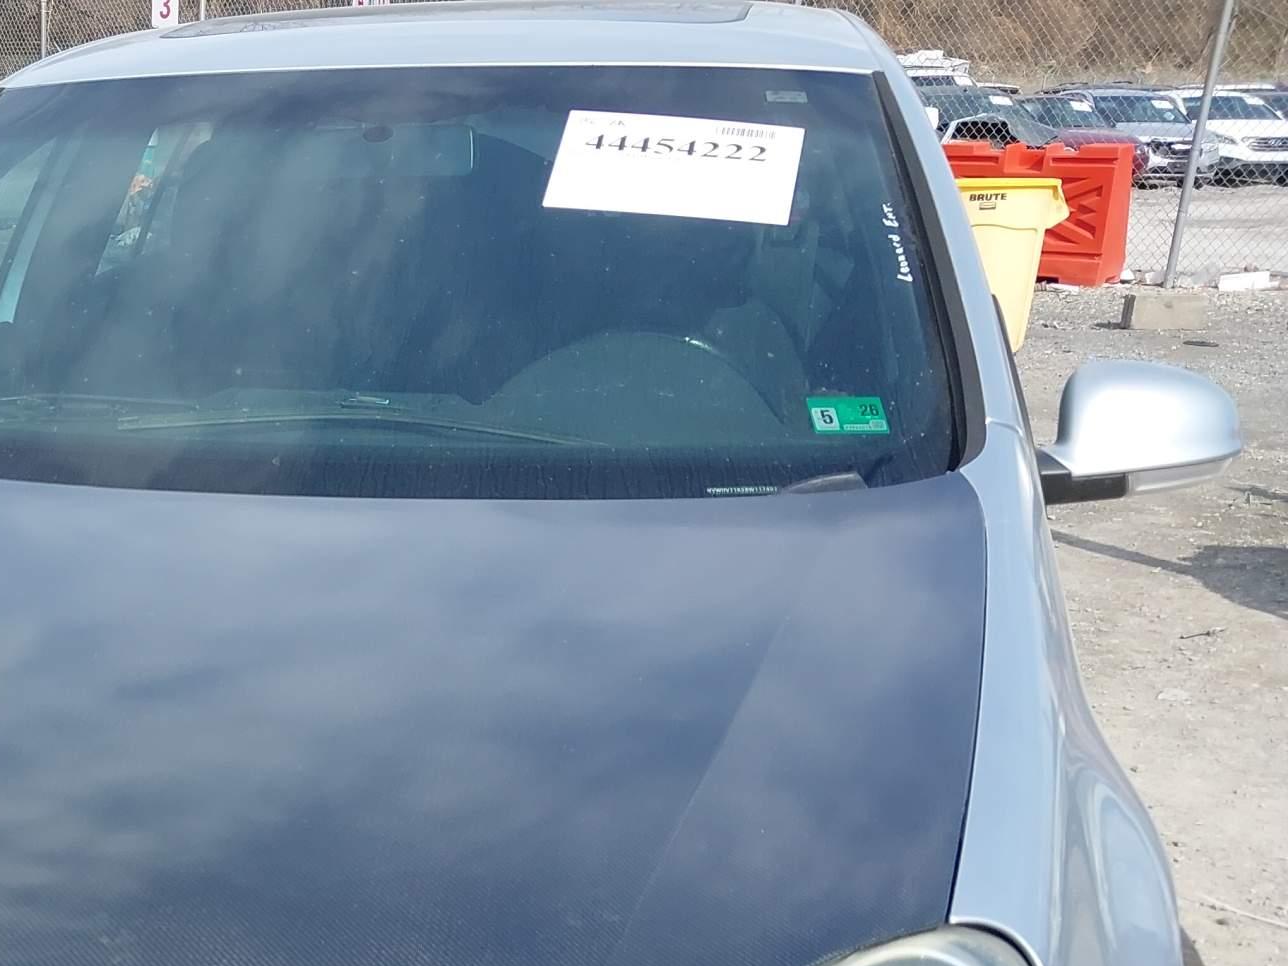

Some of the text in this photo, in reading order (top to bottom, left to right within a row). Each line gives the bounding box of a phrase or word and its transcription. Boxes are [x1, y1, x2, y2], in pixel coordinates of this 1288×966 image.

[159, 0, 171, 19] 3
[584, 133, 768, 163] 44454222
[969, 192, 1008, 202] BRUTE
[820, 409, 834, 425] 5
[859, 403, 880, 417] 26
